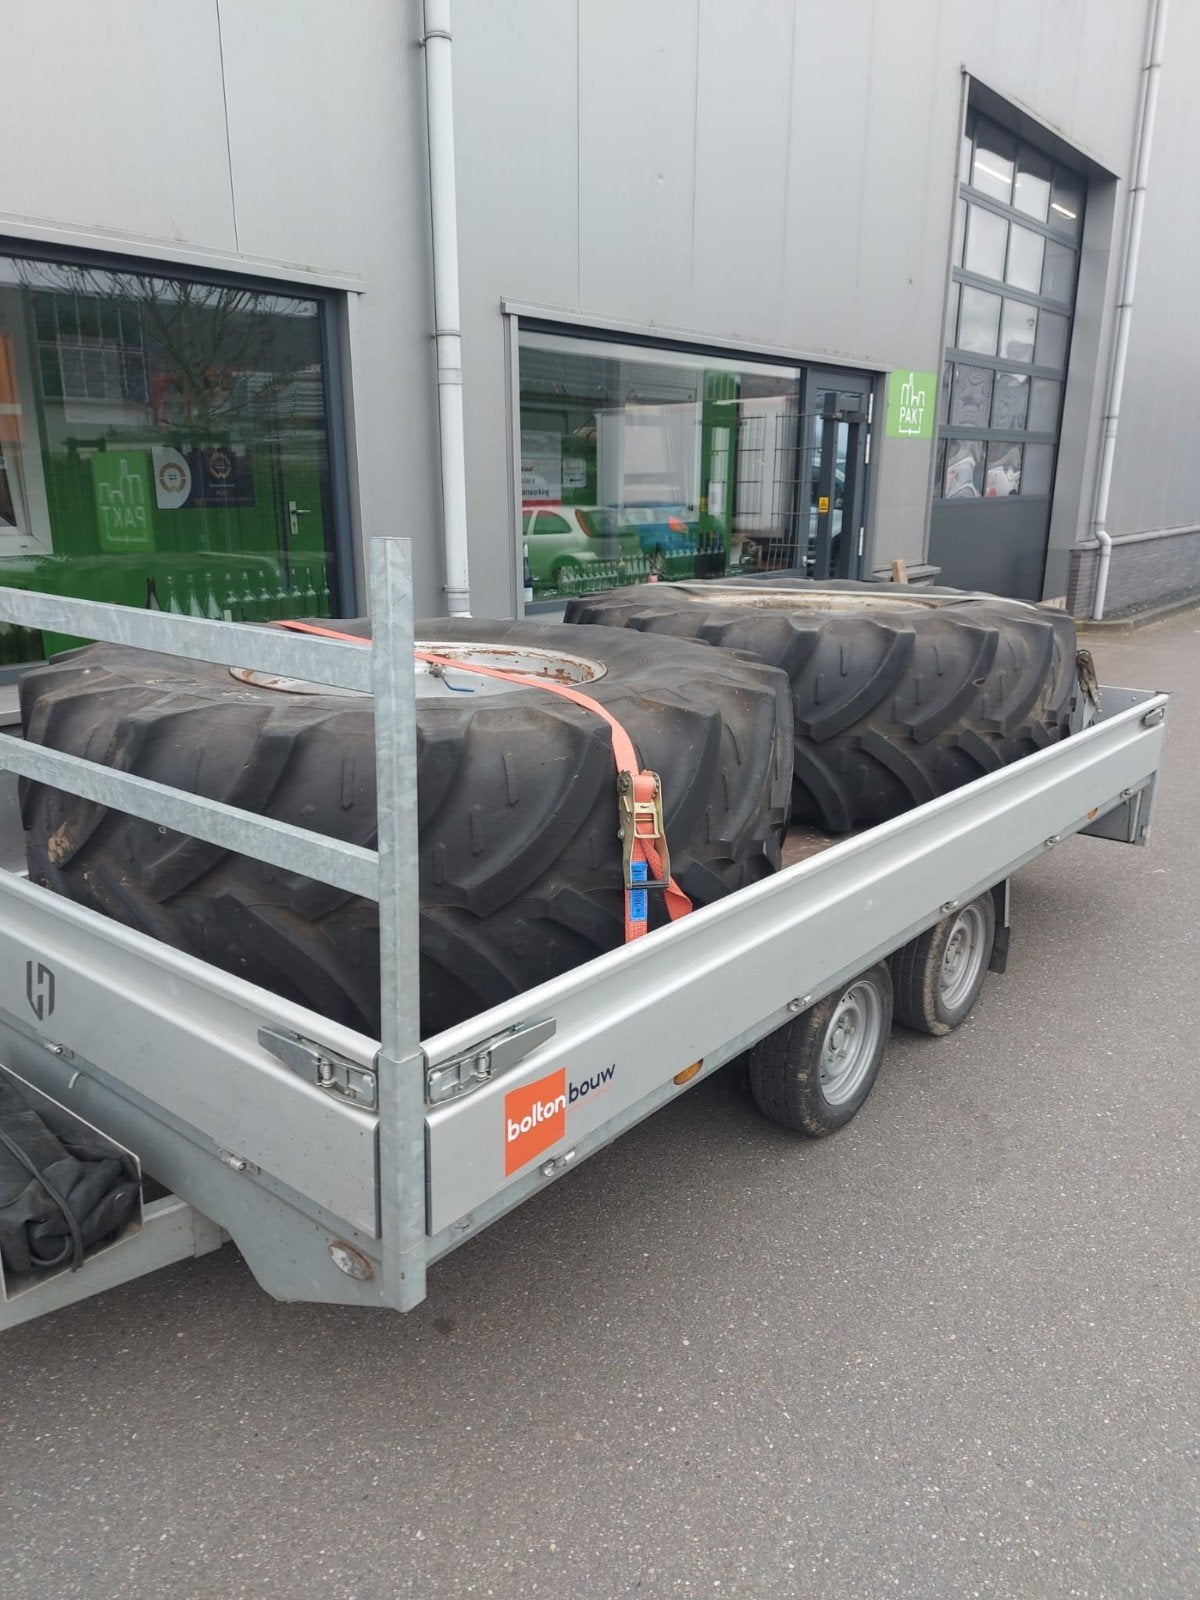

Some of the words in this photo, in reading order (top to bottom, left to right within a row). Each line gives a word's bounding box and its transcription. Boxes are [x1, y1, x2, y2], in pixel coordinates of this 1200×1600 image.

[899, 406, 924, 424] PAKT
[507, 1094, 566, 1142] bolton
[568, 1063, 616, 1104] bouw
